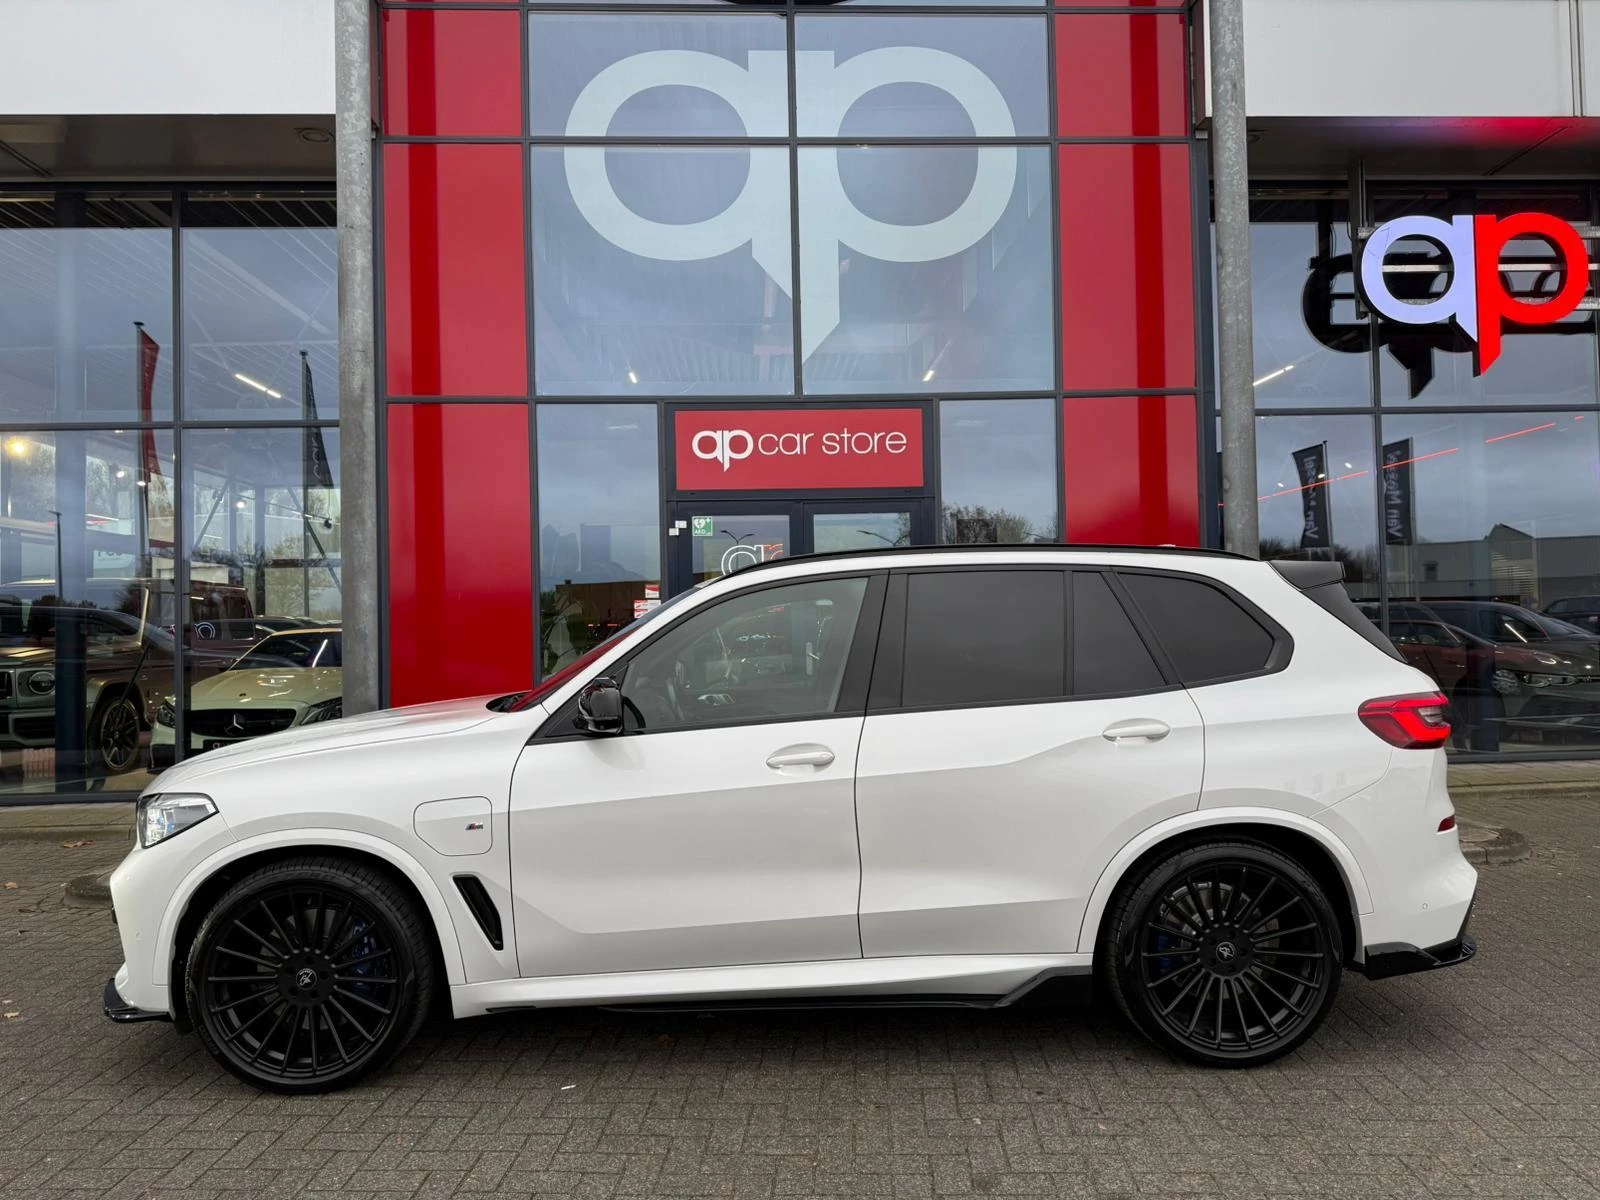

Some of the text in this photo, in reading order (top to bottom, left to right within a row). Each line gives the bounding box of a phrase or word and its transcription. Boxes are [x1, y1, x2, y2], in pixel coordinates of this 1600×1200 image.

[1361, 212, 1590, 376] ap
[692, 427, 907, 473] ap car store
